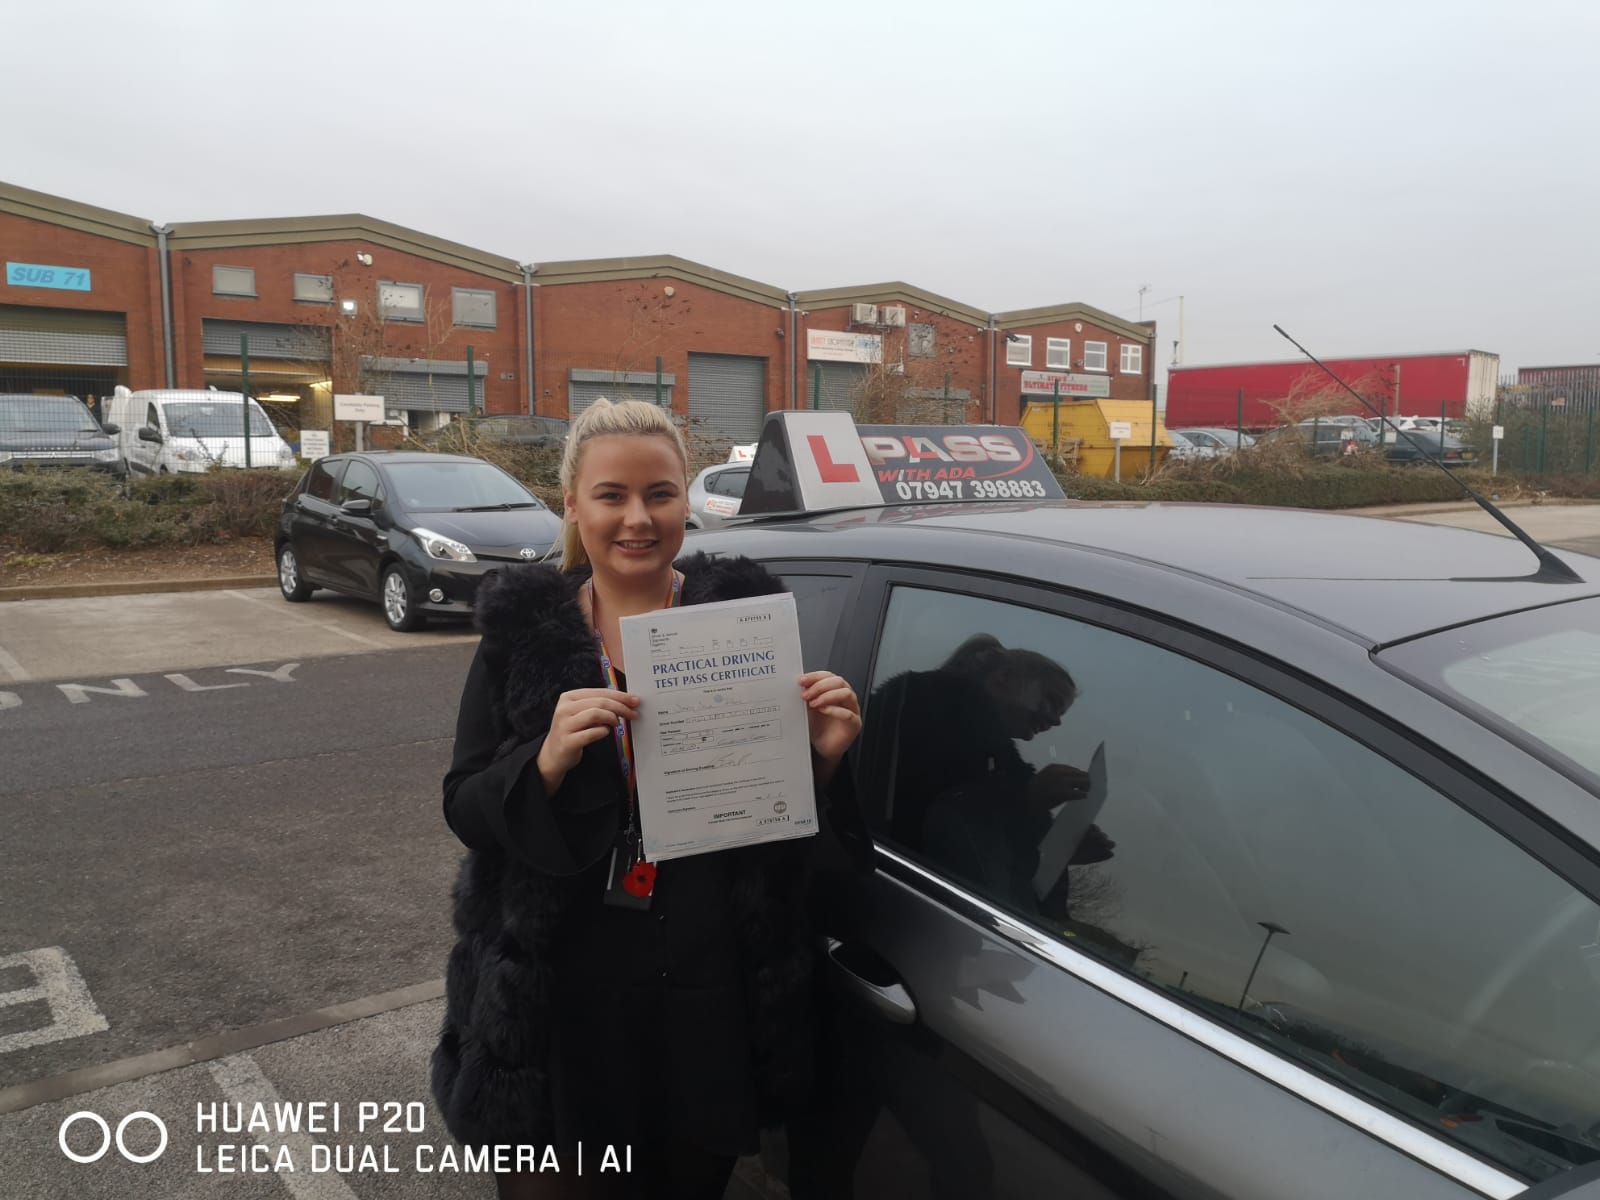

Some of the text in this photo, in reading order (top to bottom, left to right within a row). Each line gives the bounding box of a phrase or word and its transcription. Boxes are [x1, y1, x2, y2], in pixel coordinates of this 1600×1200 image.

[11, 267, 86, 287] SUB 71
[738, 450, 747, 458] L
[807, 435, 860, 483] L
[862, 435, 1022, 464] PASS
[878, 466, 976, 482] WITH ADA
[896, 480, 1046, 500] 07947 398883
[652, 650, 775, 675] PRACTICAL DRIVING
[0, 664, 300, 710] NLY
[655, 664, 776, 689] TEST PASS CERTIFICATE
[713, 809, 746, 819] IMPORTANT
